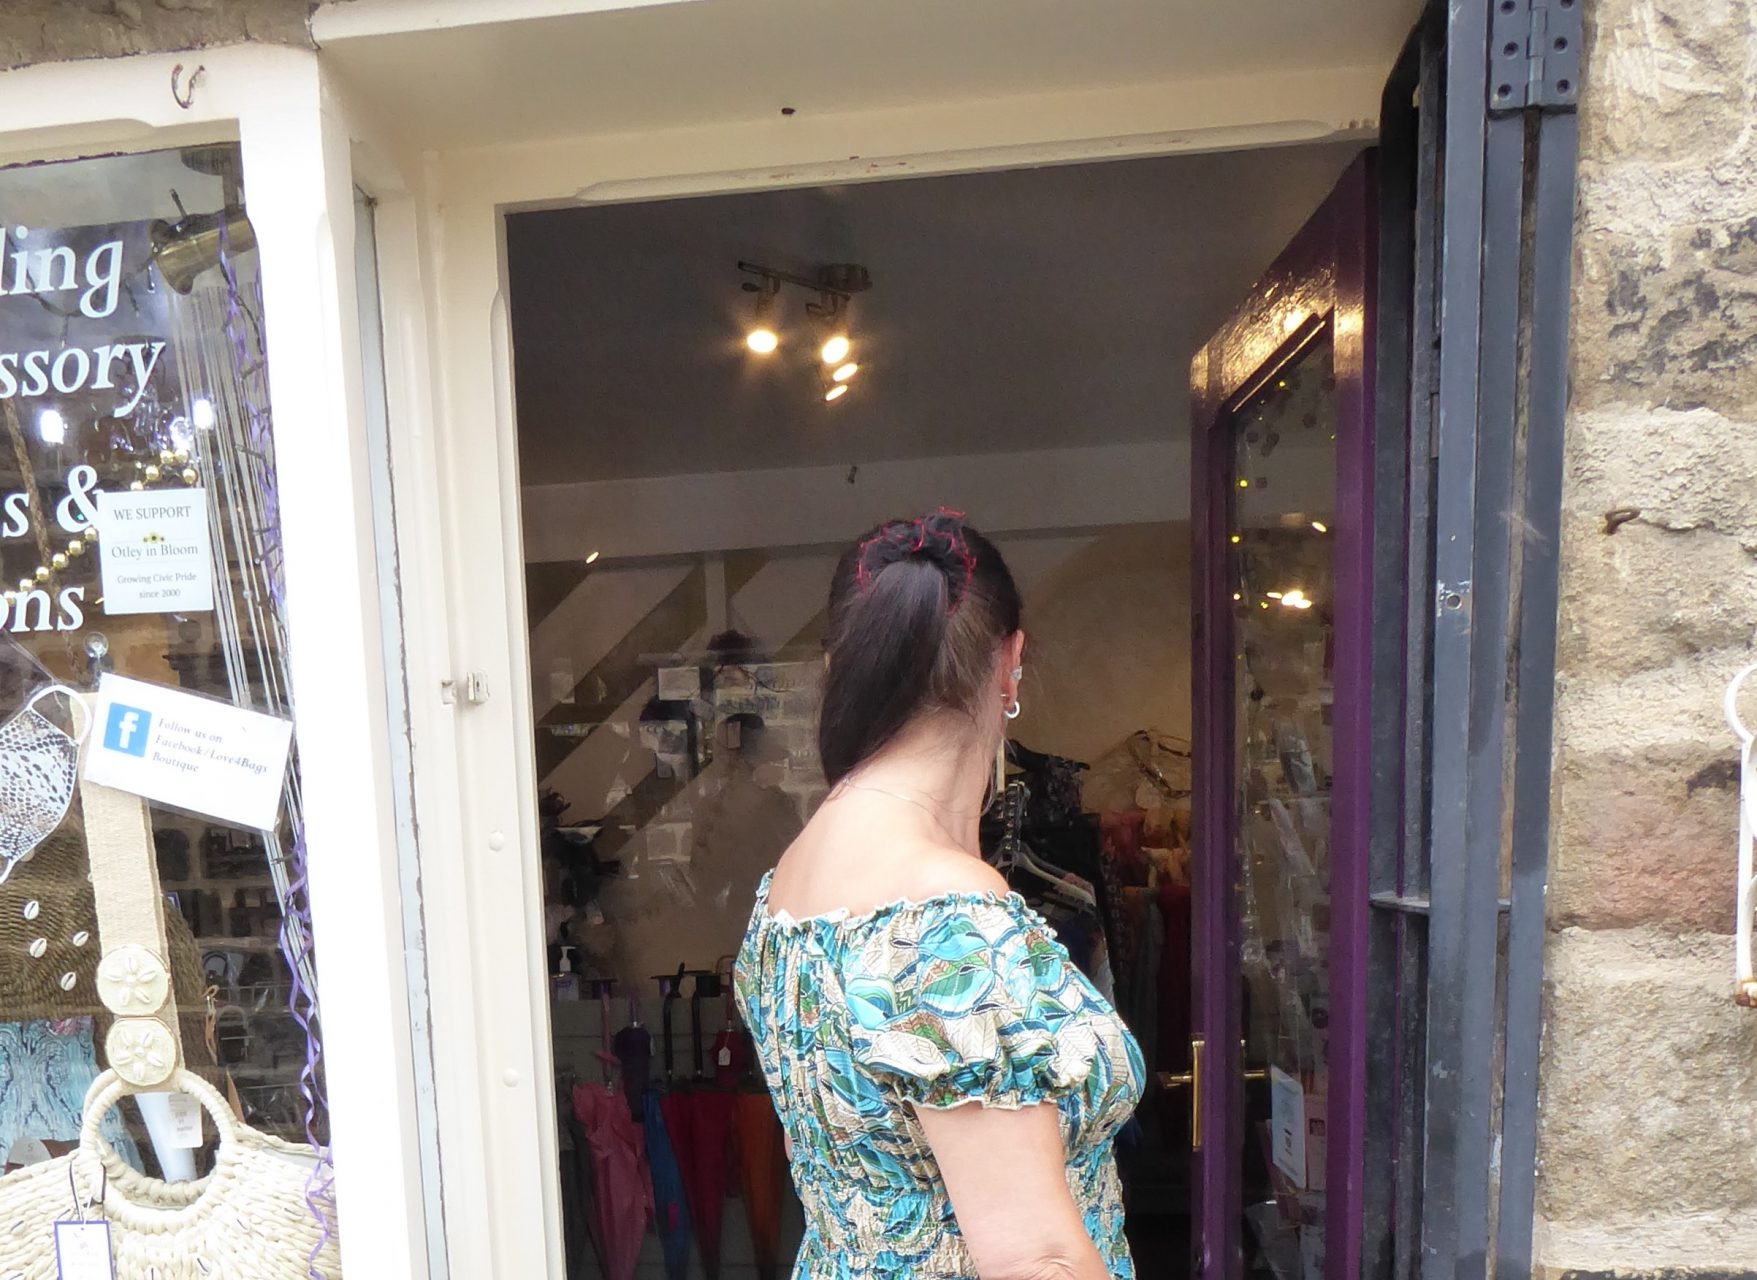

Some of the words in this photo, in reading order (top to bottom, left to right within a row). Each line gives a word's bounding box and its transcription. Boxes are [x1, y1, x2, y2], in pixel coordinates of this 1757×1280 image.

[114, 509, 133, 520] WE
[136, 506, 191, 519] SUPPORT
[111, 546, 142, 561] Otley
[146, 545, 157, 557] in
[161, 544, 198, 556] Bloom
[117, 575, 152, 585] Growing
[153, 574, 173, 582] Civic
[175, 572, 197, 581] Pride
[139, 590, 160, 598] since
[162, 589, 181, 598] 2000
[0, 586, 84, 632] ns
[158, 717, 192, 734] Follow
[195, 730, 206, 739] us
[209, 734, 222, 743] on
[152, 752, 199, 773] Boutique
